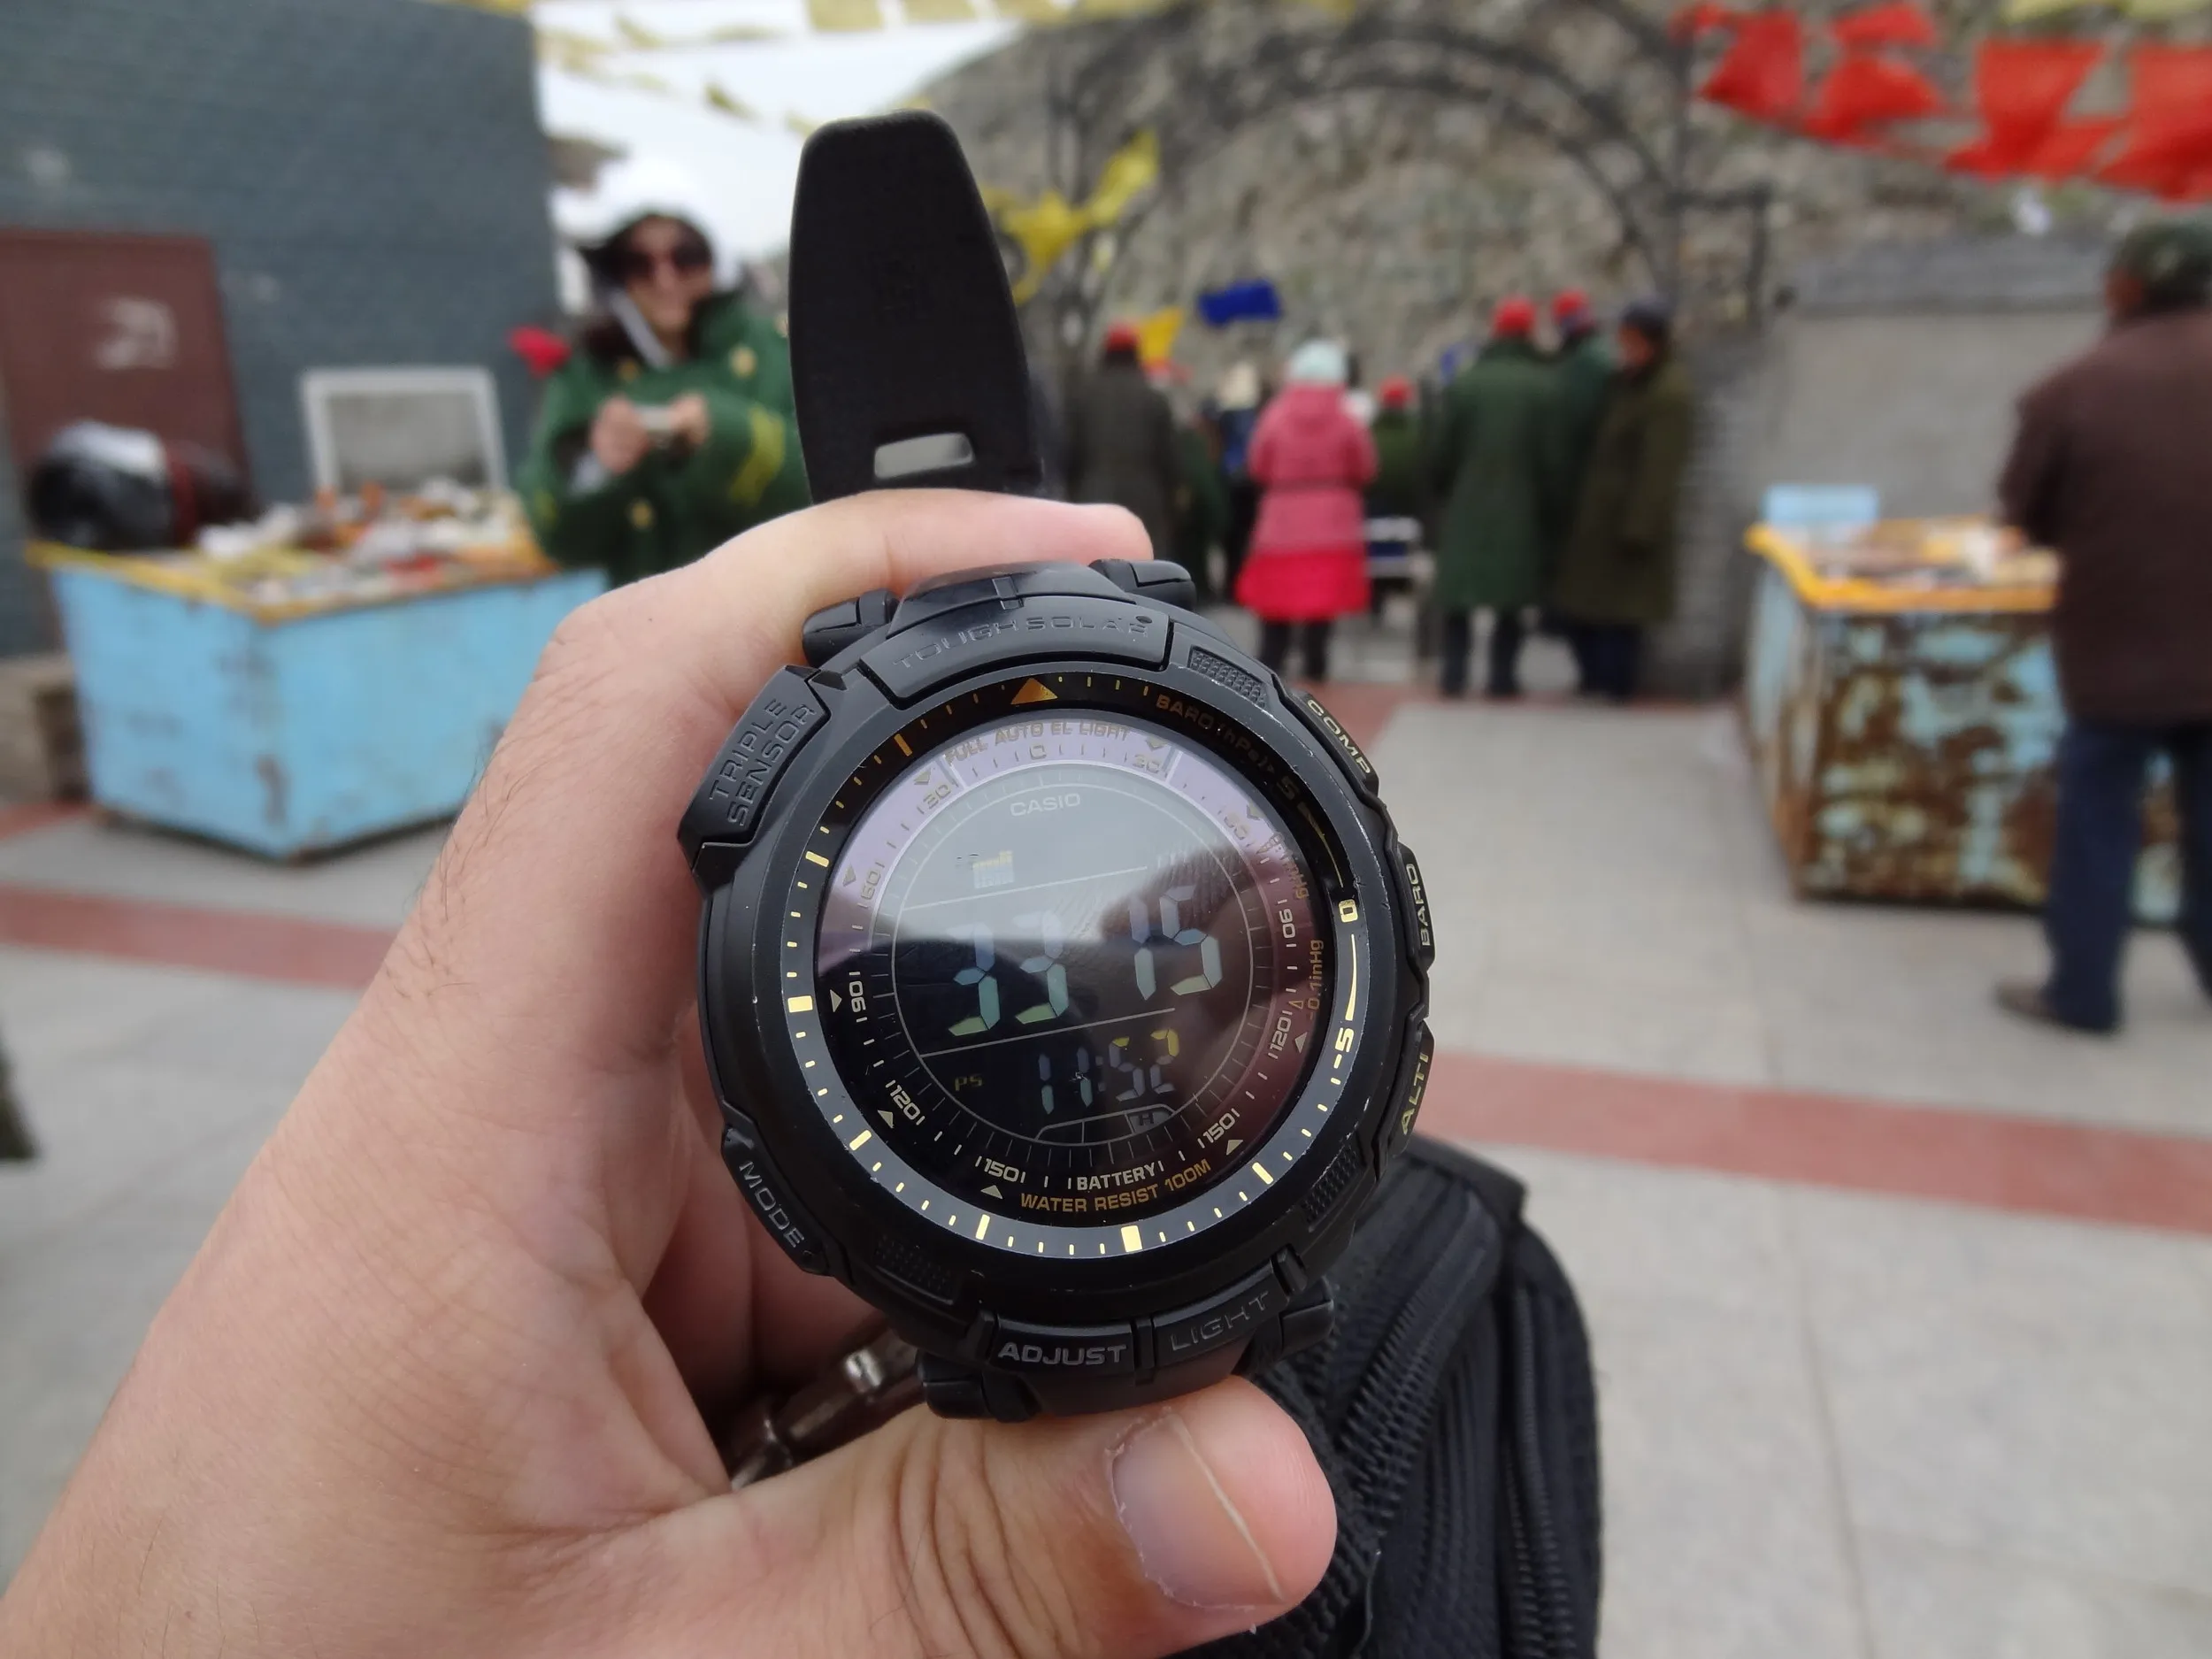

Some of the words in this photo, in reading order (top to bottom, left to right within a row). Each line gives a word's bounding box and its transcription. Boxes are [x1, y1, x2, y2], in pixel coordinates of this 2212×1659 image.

[894, 618, 1018, 669] TOUGH
[1025, 616, 1148, 638] SOLAR
[1156, 694, 1215, 730] BARO
[1307, 698, 1371, 775] COMP
[710, 698, 787, 801] TRIPLE
[728, 703, 816, 826] SENSOR
[944, 737, 989, 766] FULL
[995, 721, 1044, 745] AUTO
[1050, 721, 1073, 736] EL
[1079, 721, 1131, 741] LIGHT
[1010, 793, 1081, 817] CASIO
[1408, 863, 1432, 948] BARO
[1038, 1027, 1180, 1115] 11:52
[1401, 1052, 1430, 1136] ALTI
[739, 1160, 805, 1248] MODE
[1020, 1193, 1087, 1213] WATER
[1094, 1184, 1157, 1211] RESIST
[1164, 1159, 1212, 1193] 100M
[1077, 1162, 1157, 1191] BATTERY
[1170, 1290, 1271, 1351] LIGHT
[997, 1341, 1127, 1366] ADJUST
